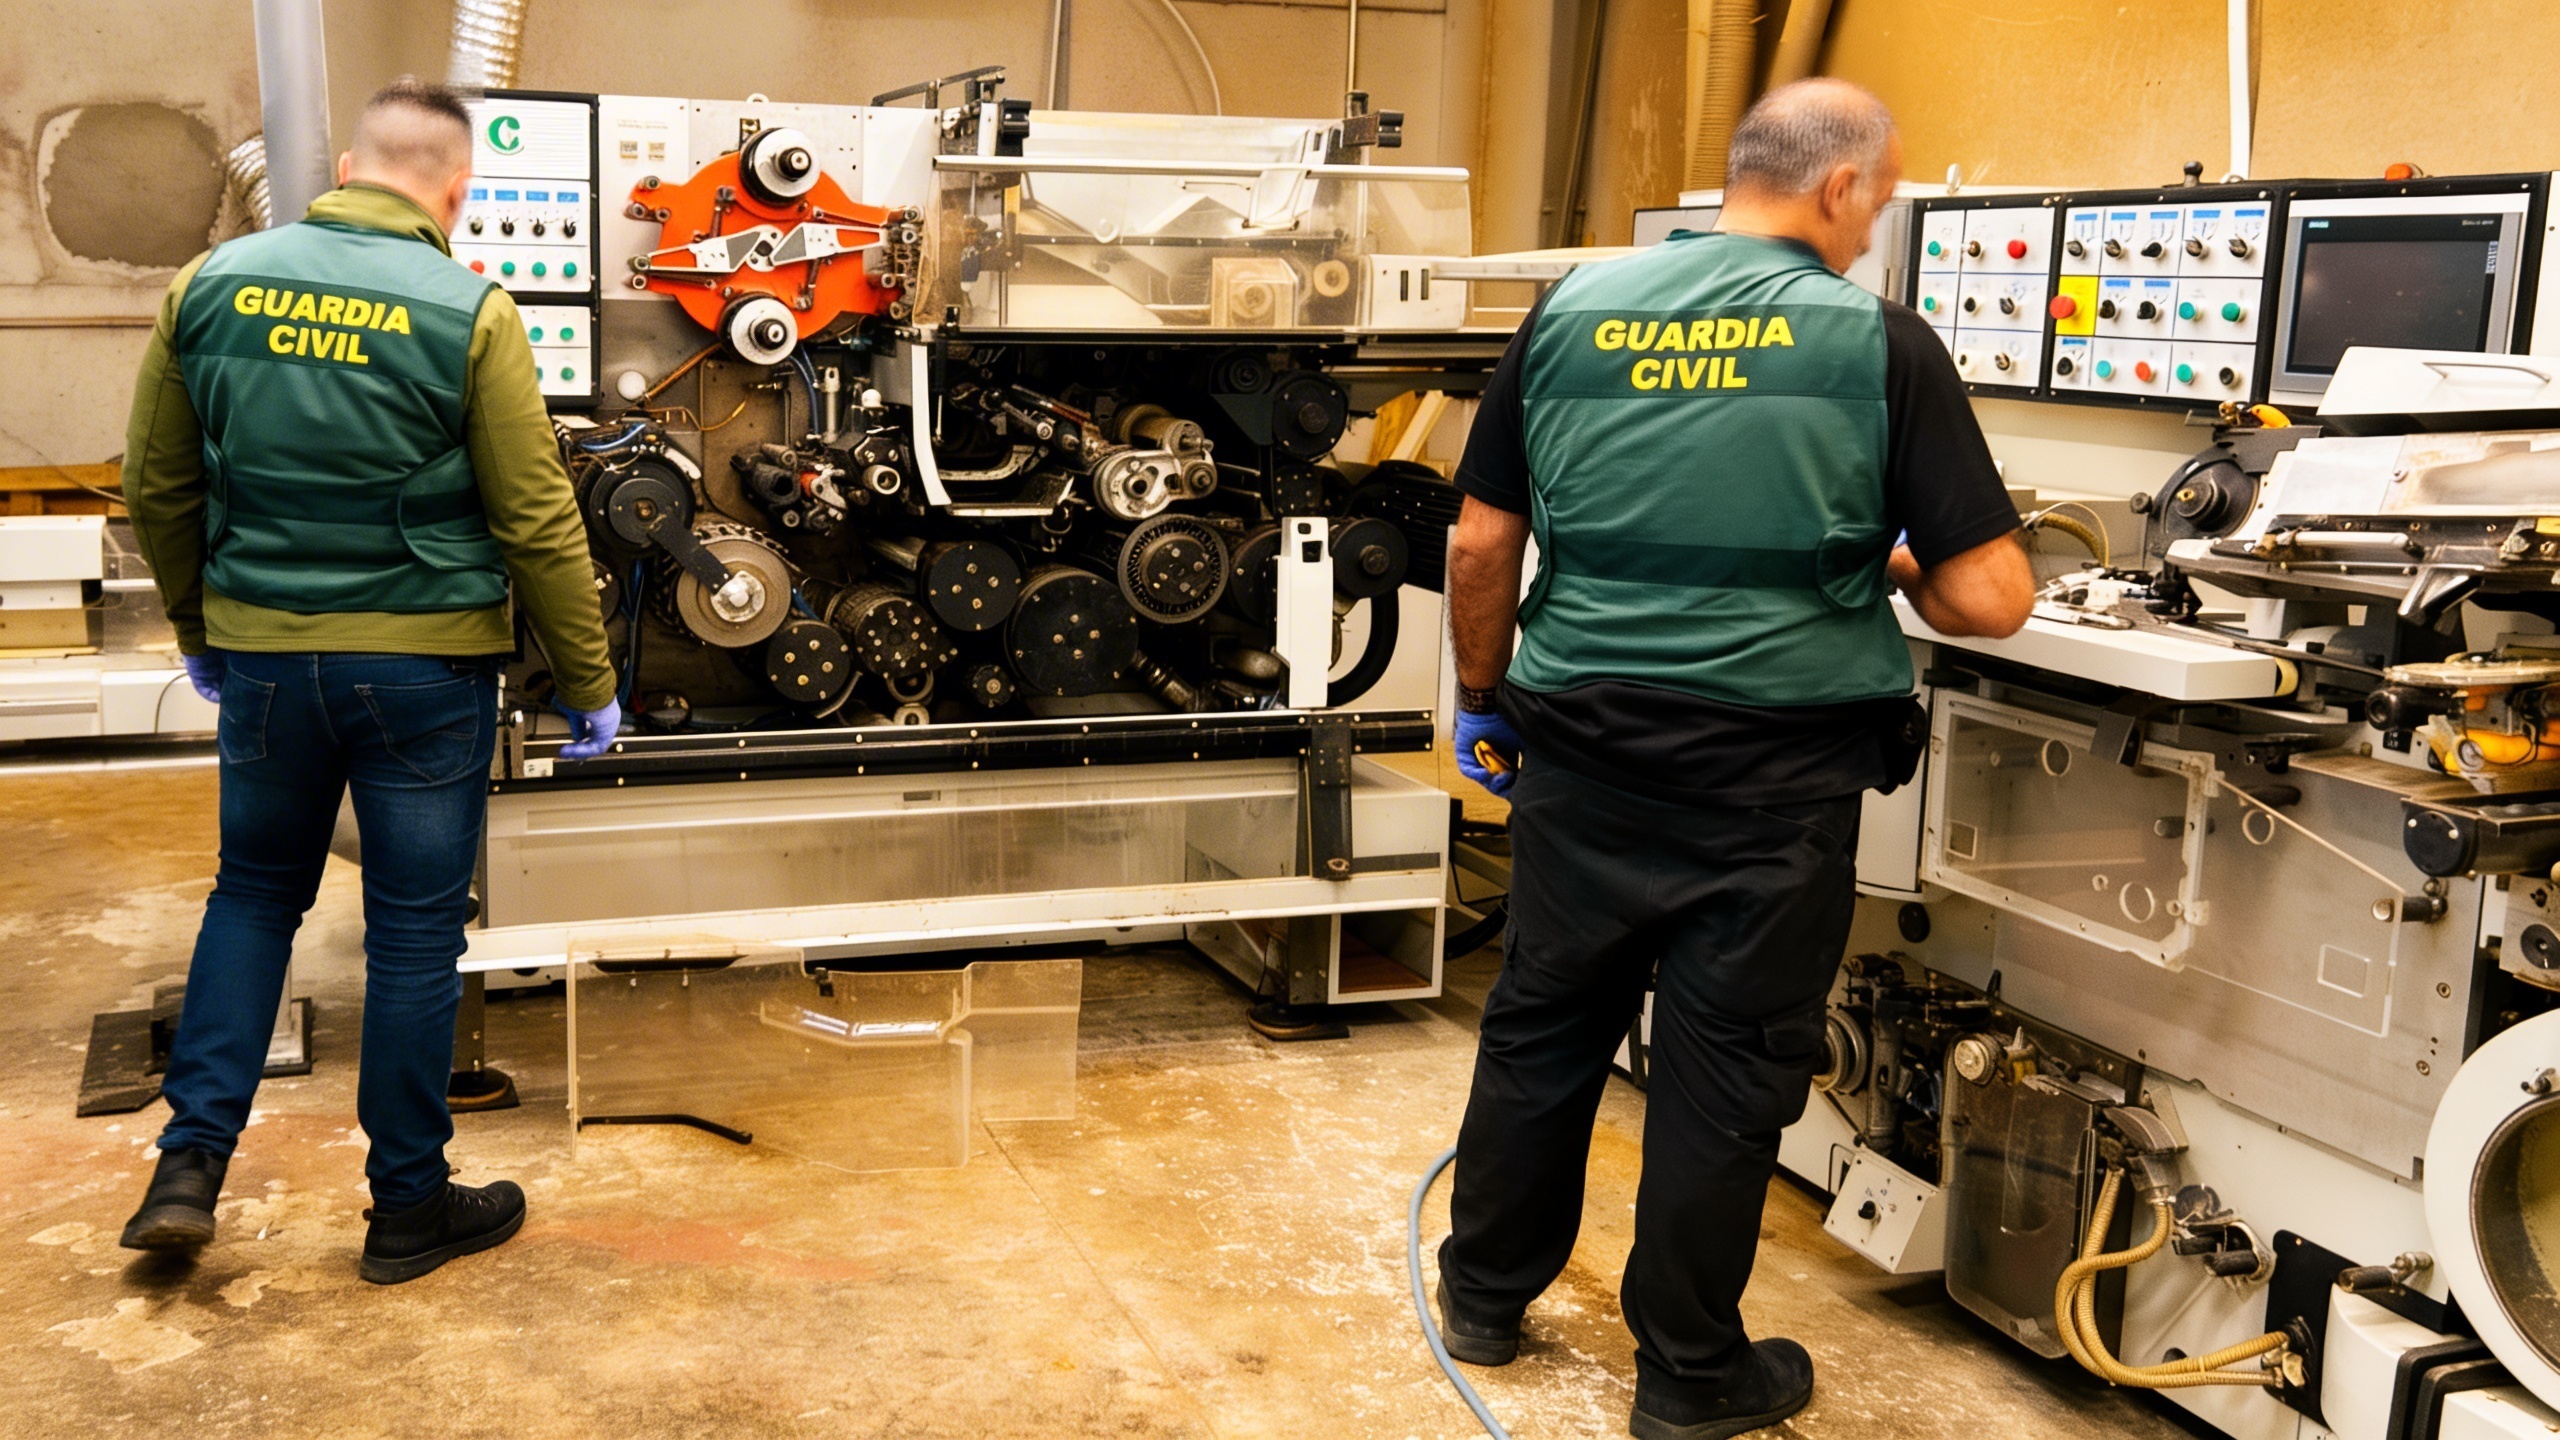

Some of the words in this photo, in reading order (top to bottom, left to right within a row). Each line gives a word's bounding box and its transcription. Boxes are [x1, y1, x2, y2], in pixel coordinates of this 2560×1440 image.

[234, 286, 410, 334] GUARDIA
[269, 325, 369, 364] CIVIL
[1595, 317, 1794, 351] GUARDIA
[1631, 357, 1747, 390] CIVIL
